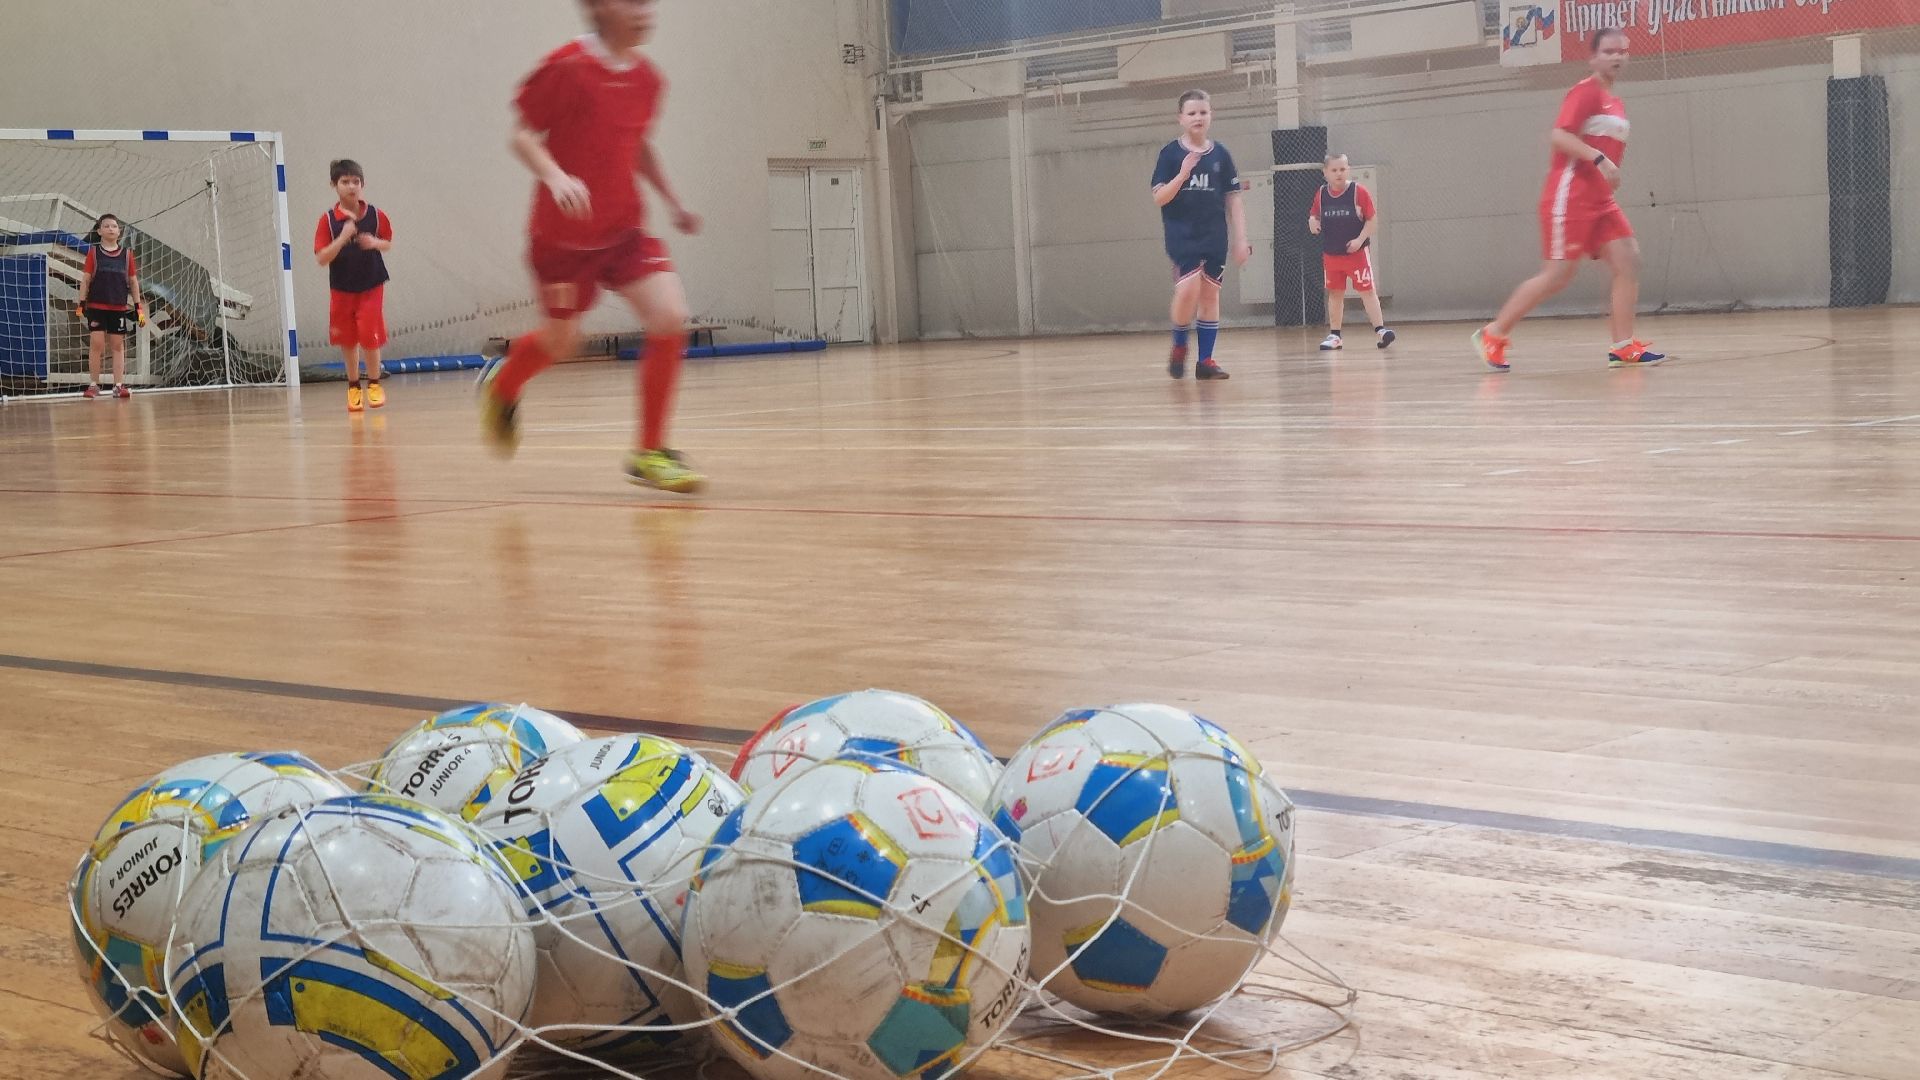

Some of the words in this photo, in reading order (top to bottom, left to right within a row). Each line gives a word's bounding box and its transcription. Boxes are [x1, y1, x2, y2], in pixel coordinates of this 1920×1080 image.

[1565, 1, 1638, 41] Привет
[1353, 267, 1371, 284] 14
[119, 317, 125, 328] 1
[429, 754, 465, 797] JUNIOR
[116, 836, 158, 880] JUNIOR
[112, 846, 187, 919] TORRES
